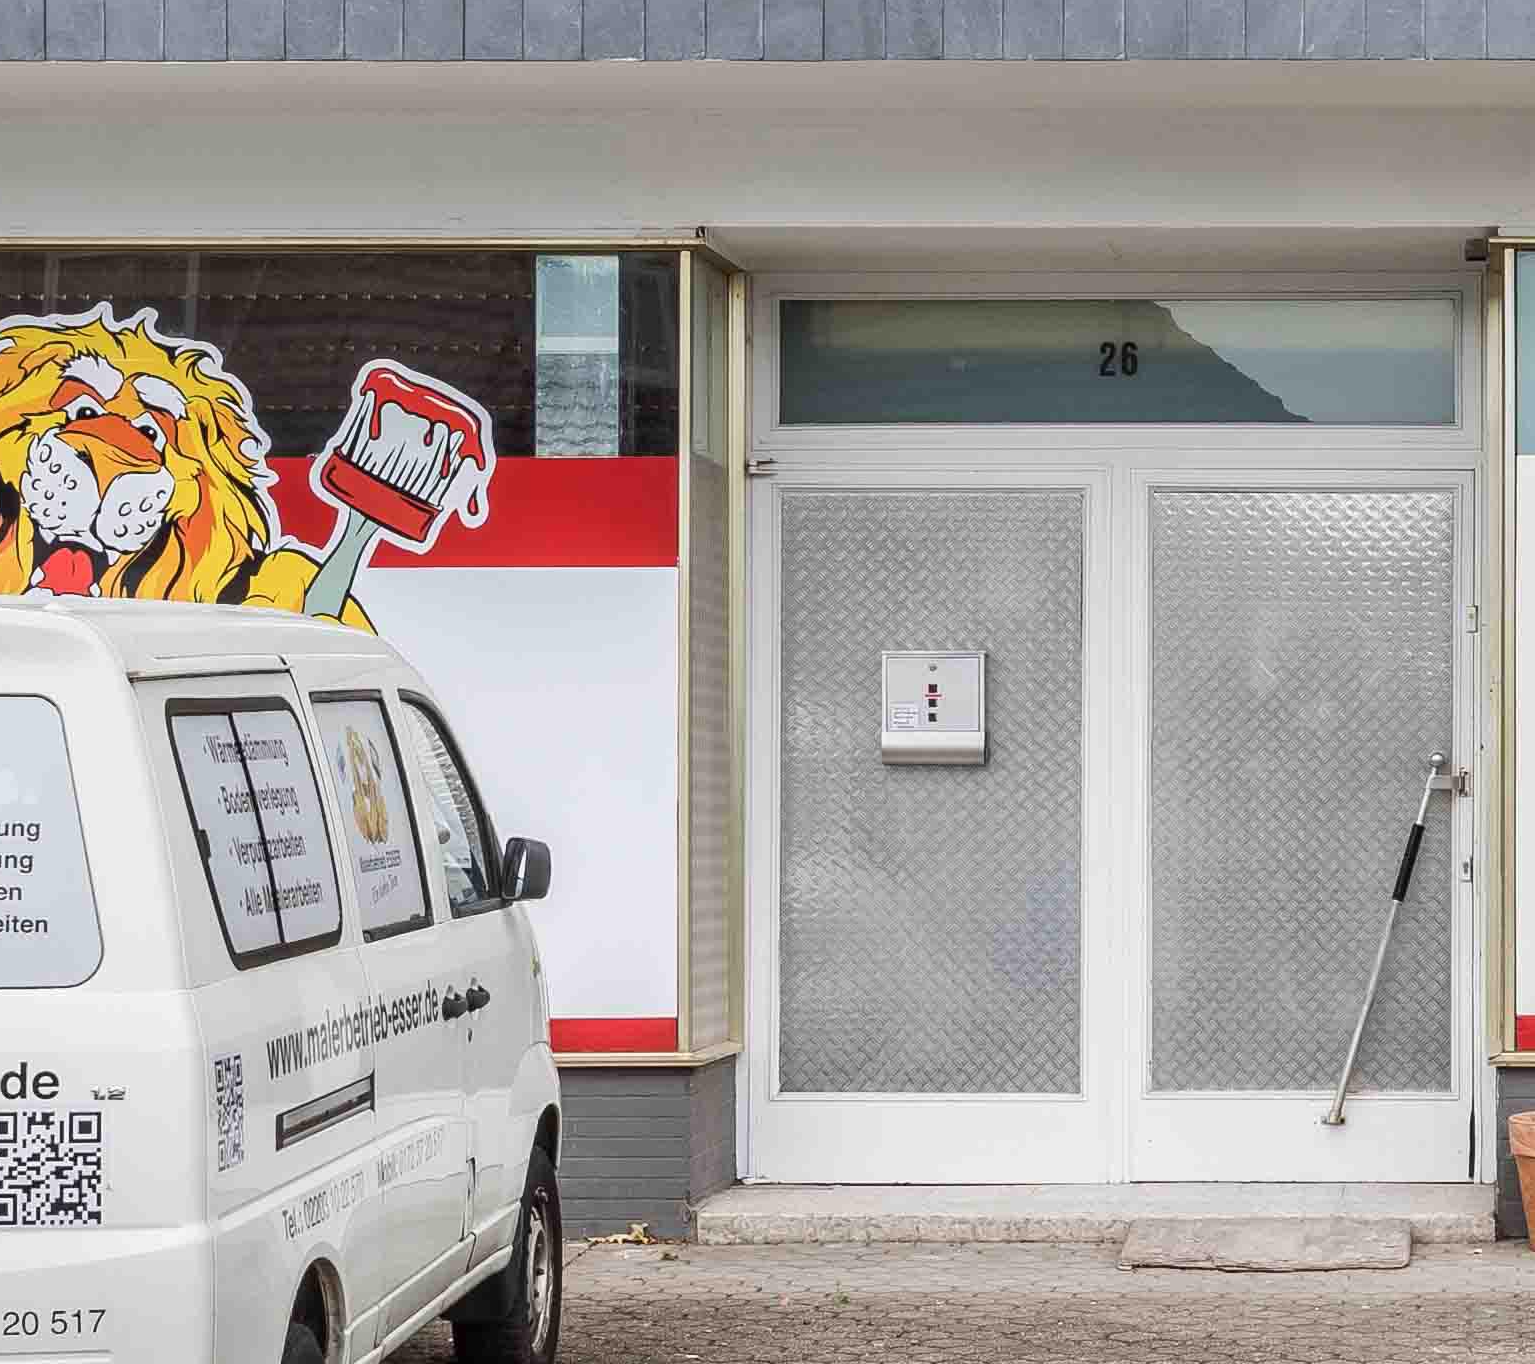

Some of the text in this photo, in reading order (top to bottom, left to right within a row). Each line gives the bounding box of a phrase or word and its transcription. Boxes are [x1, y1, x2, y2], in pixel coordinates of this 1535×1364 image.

[1099, 341, 1139, 378] 26
[266, 979, 440, 1080] www.malerbetrieb-esser.de
[2, 1309, 40, 1337] 20
[50, 1309, 107, 1335] 517
